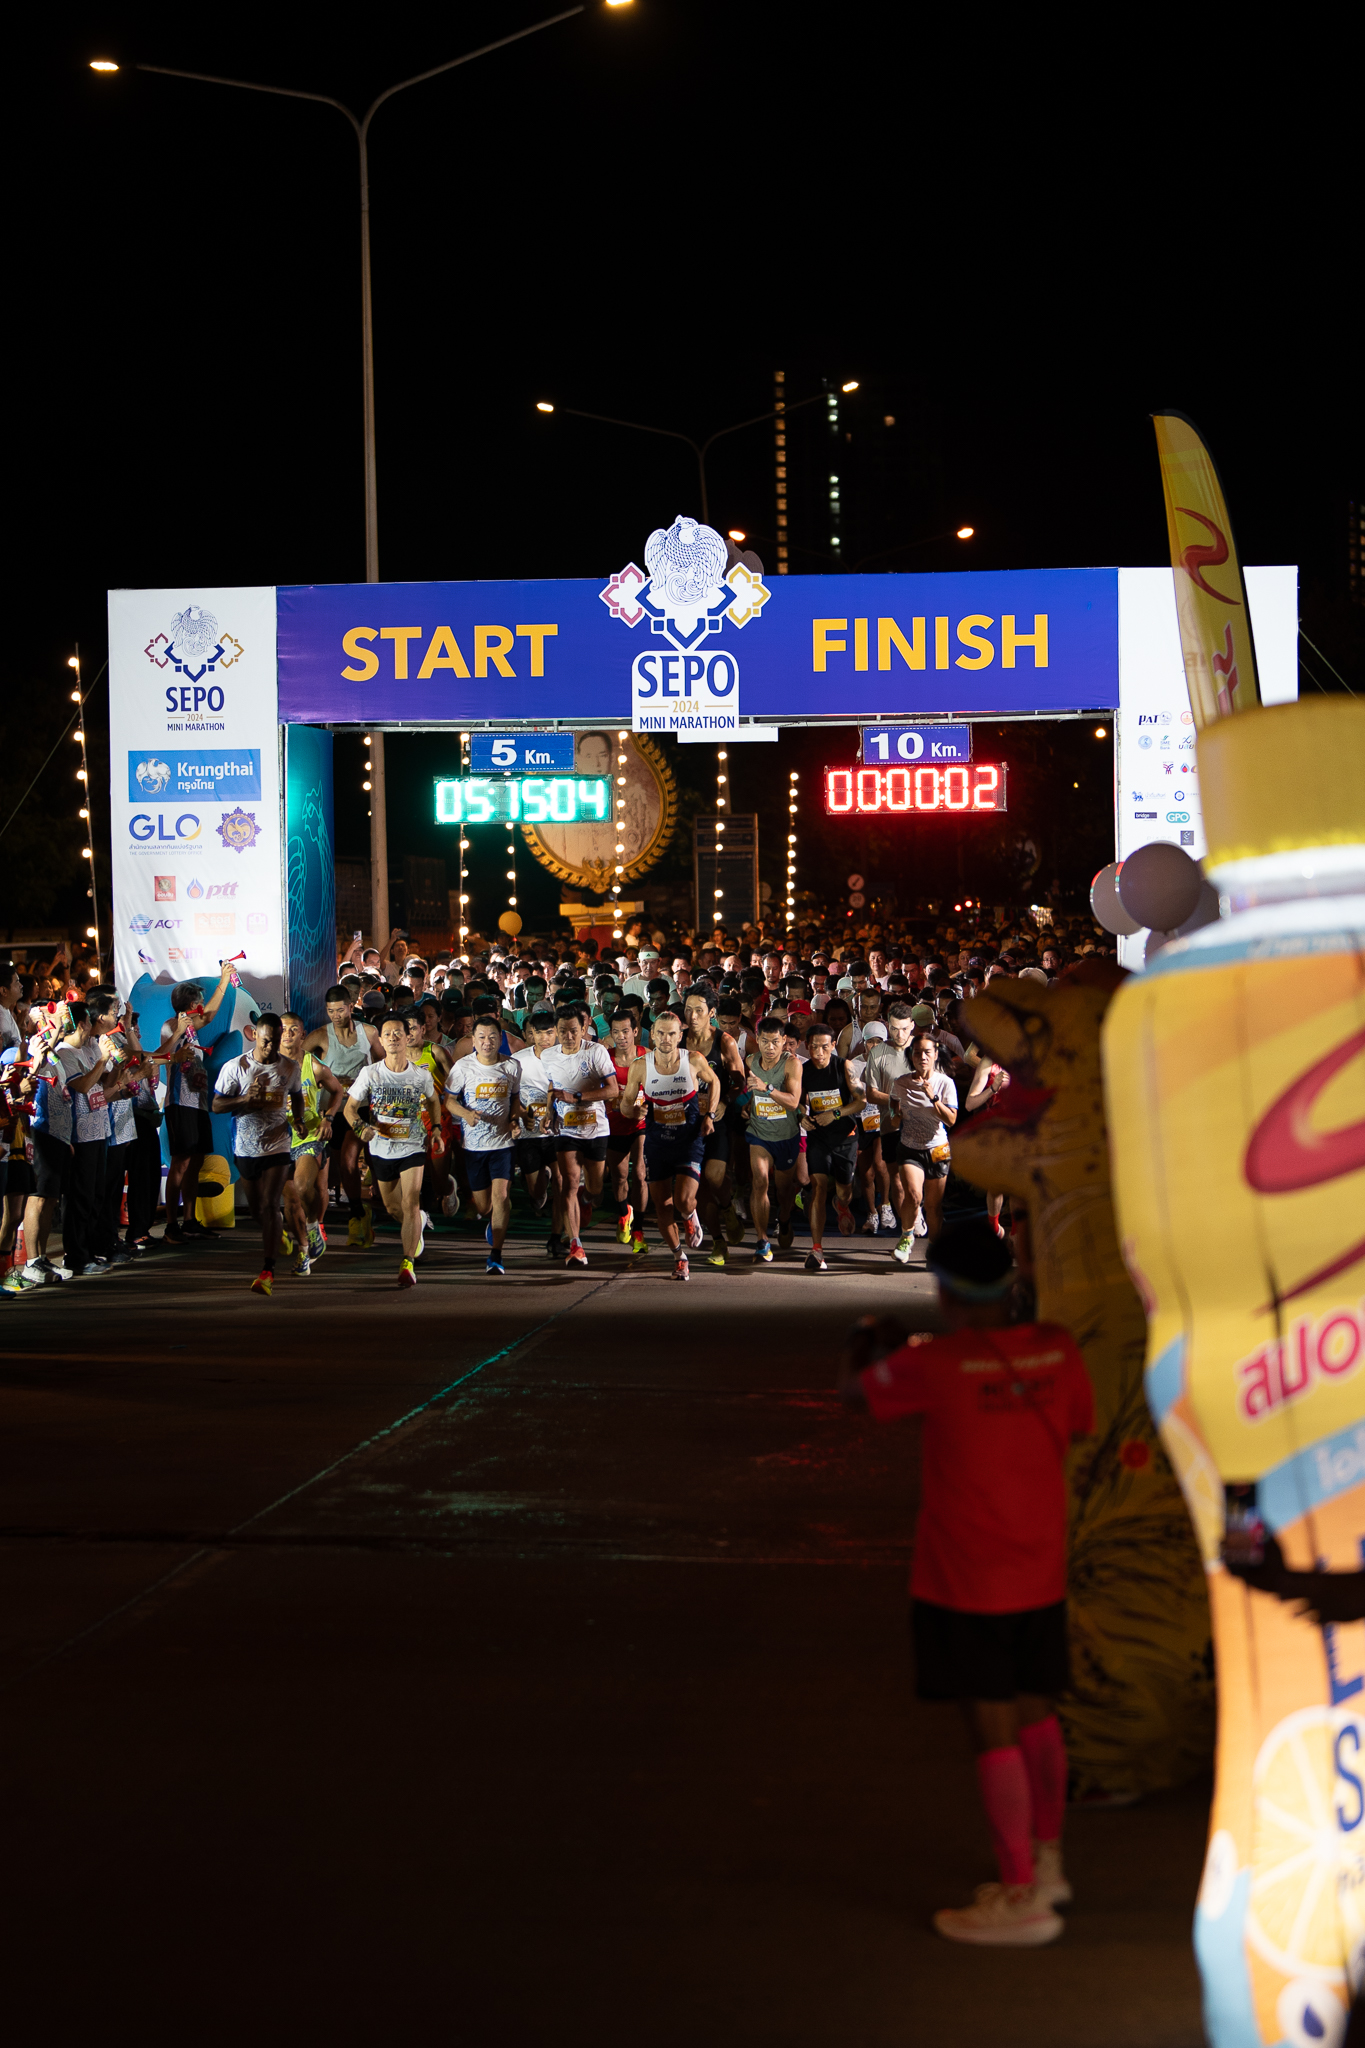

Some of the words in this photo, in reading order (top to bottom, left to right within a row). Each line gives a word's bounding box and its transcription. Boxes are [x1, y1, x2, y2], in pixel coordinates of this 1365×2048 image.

[340, 623, 558, 682] START
[812, 614, 1049, 672] FINISH
[638, 654, 735, 698] SEPO
[166, 686, 224, 712] SEPO
[672, 700, 699, 713] 2024
[167, 723, 183, 731] MINI
[185, 722, 225, 731] MARATHON
[187, 713, 203, 721] 2024
[640, 716, 666, 729] MINI
[669, 716, 735, 729] MARATHON
[490, 739, 517, 766] 5
[525, 750, 555, 764] Km.
[870, 732, 924, 760] 10
[931, 742, 961, 758] Km.
[177, 761, 253, 780] Krungthai
[178, 779, 215, 793] กรุงไทย
[827, 766, 998, 811] 00:00:02
[129, 813, 202, 841] GLO
[1167, 813, 1189, 822] GPO
[205, 881, 239, 900] ptt
[154, 919, 183, 929] AOT
[168, 947, 203, 960] EXIM
